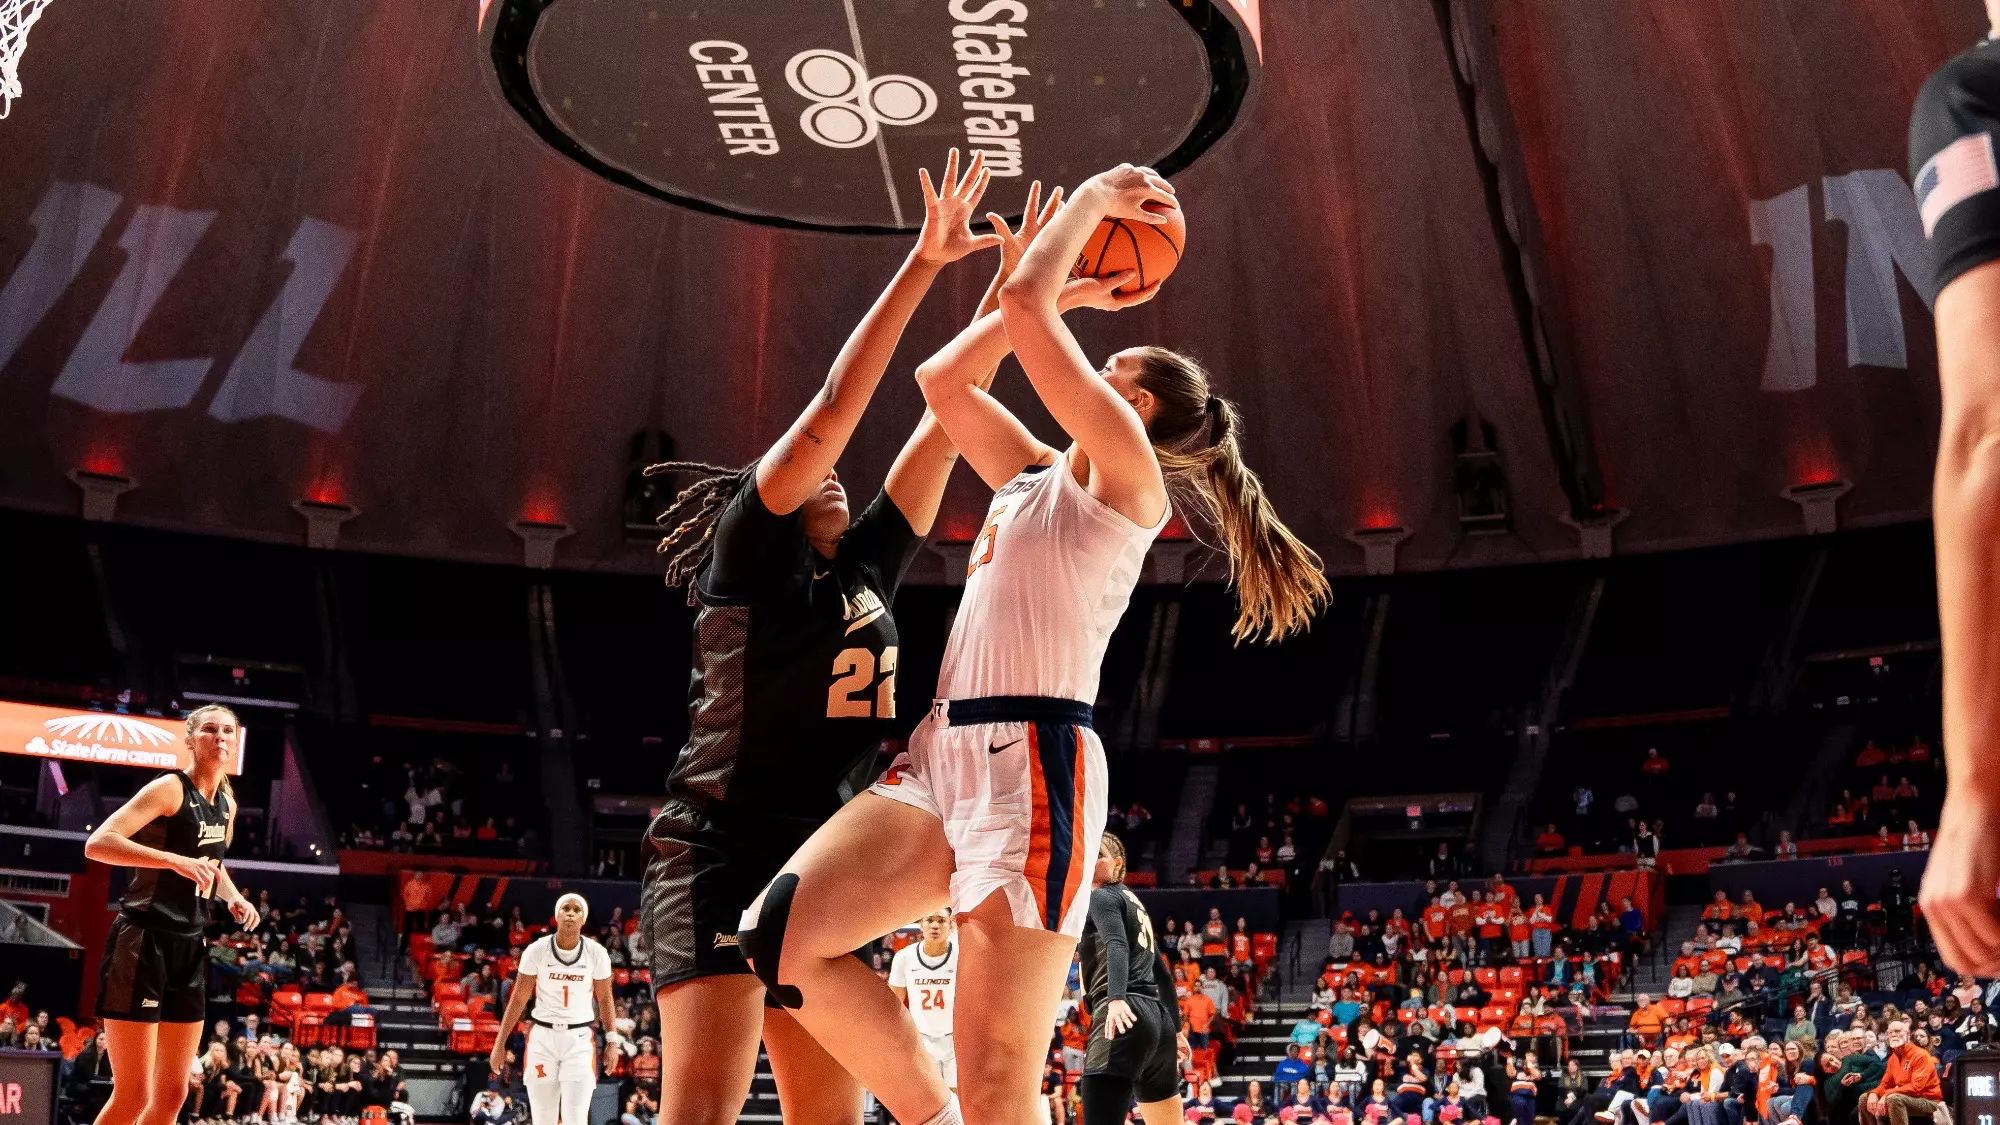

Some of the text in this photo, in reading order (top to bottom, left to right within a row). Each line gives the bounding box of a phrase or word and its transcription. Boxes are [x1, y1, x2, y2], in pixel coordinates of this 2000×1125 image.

[689, 40, 780, 156] CENTER
[128, 751, 177, 767] CENTER
[548, 972, 585, 982] ILLINOIS
[562, 985, 569, 1008] 1
[920, 989, 945, 1010] 24
